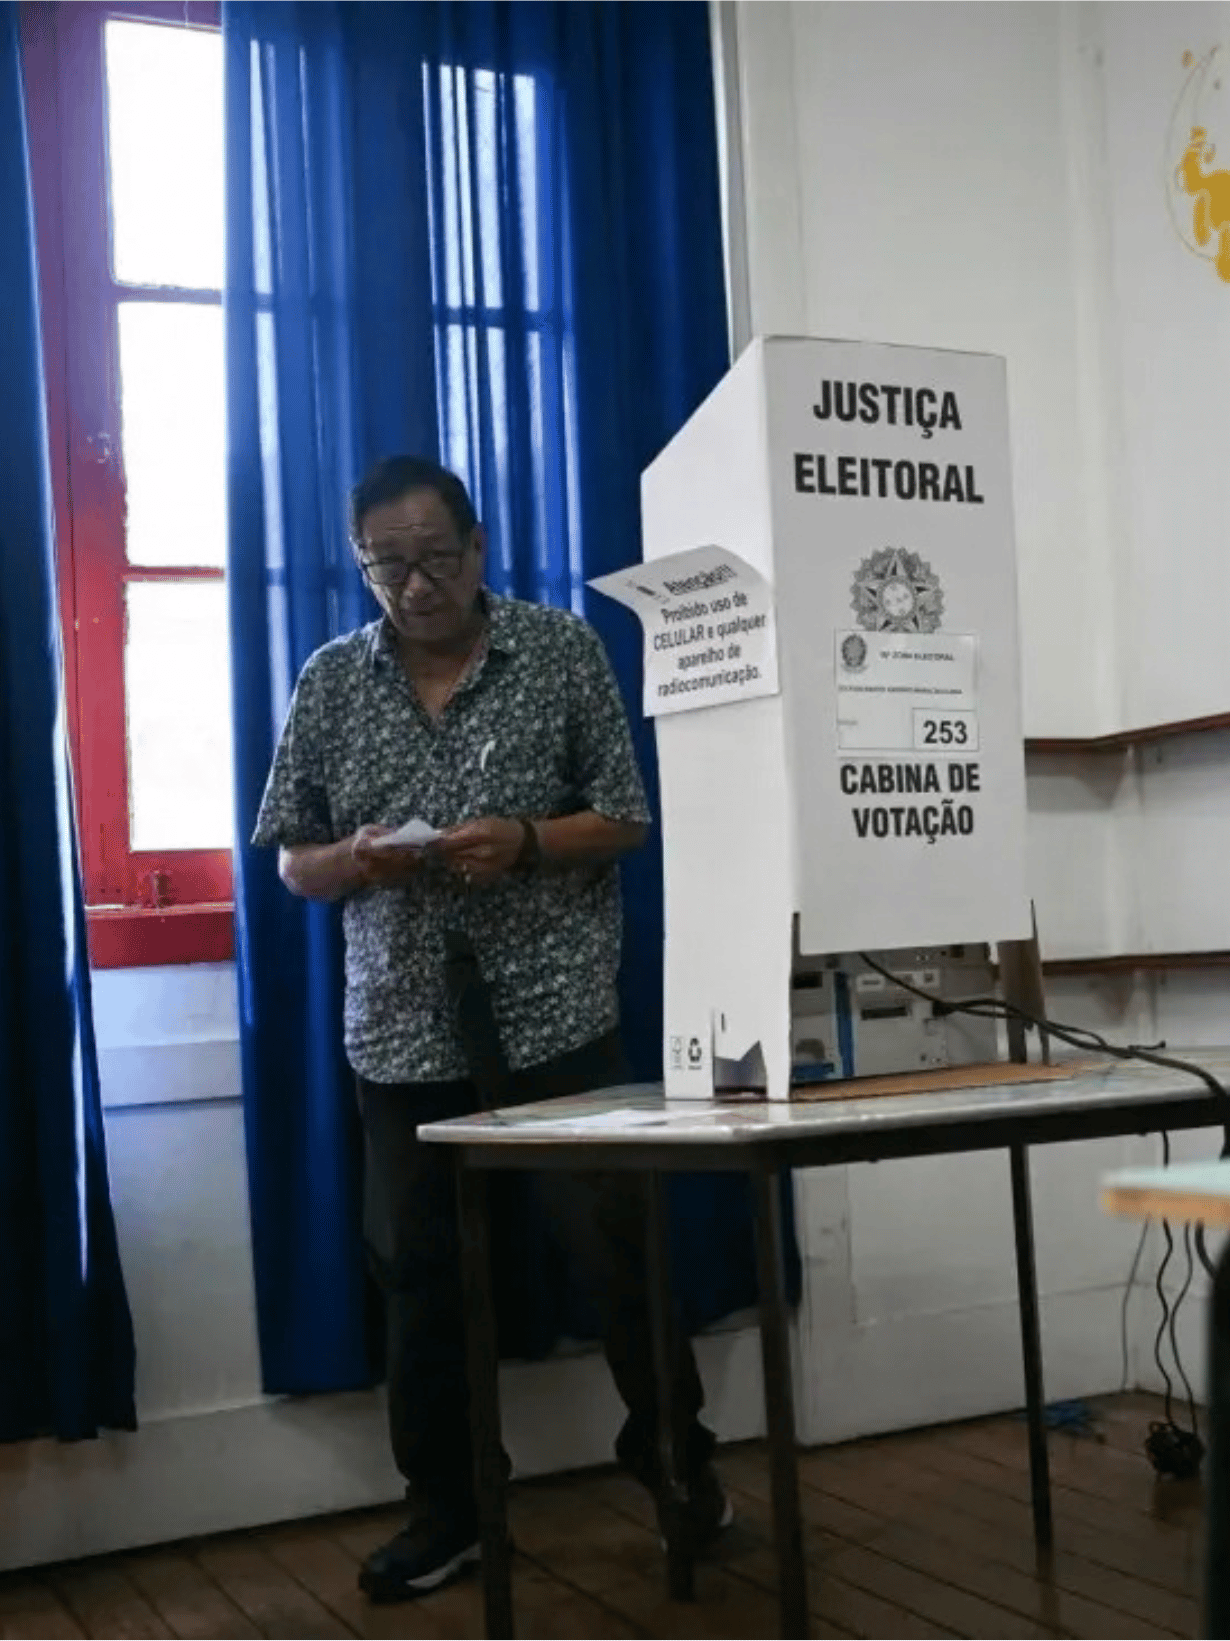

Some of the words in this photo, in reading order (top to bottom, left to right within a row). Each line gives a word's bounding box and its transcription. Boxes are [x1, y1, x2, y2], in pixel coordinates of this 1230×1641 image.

[813, 380, 962, 438] JUSTIÇA
[794, 453, 984, 503] ELEITORAL
[661, 602, 709, 624] Proibido
[710, 597, 731, 613] uso
[733, 591, 748, 607] de
[654, 624, 704, 651] CELULAR
[708, 626, 714, 639] e
[717, 614, 766, 639] qualquer
[678, 648, 724, 671] aparelho
[728, 643, 741, 659] de
[658, 664, 762, 697] radiocomunicação.
[923, 720, 968, 744] 253
[840, 764, 940, 794] CABINA
[948, 763, 981, 792] DE
[853, 799, 974, 844] VOTAÇÃO
